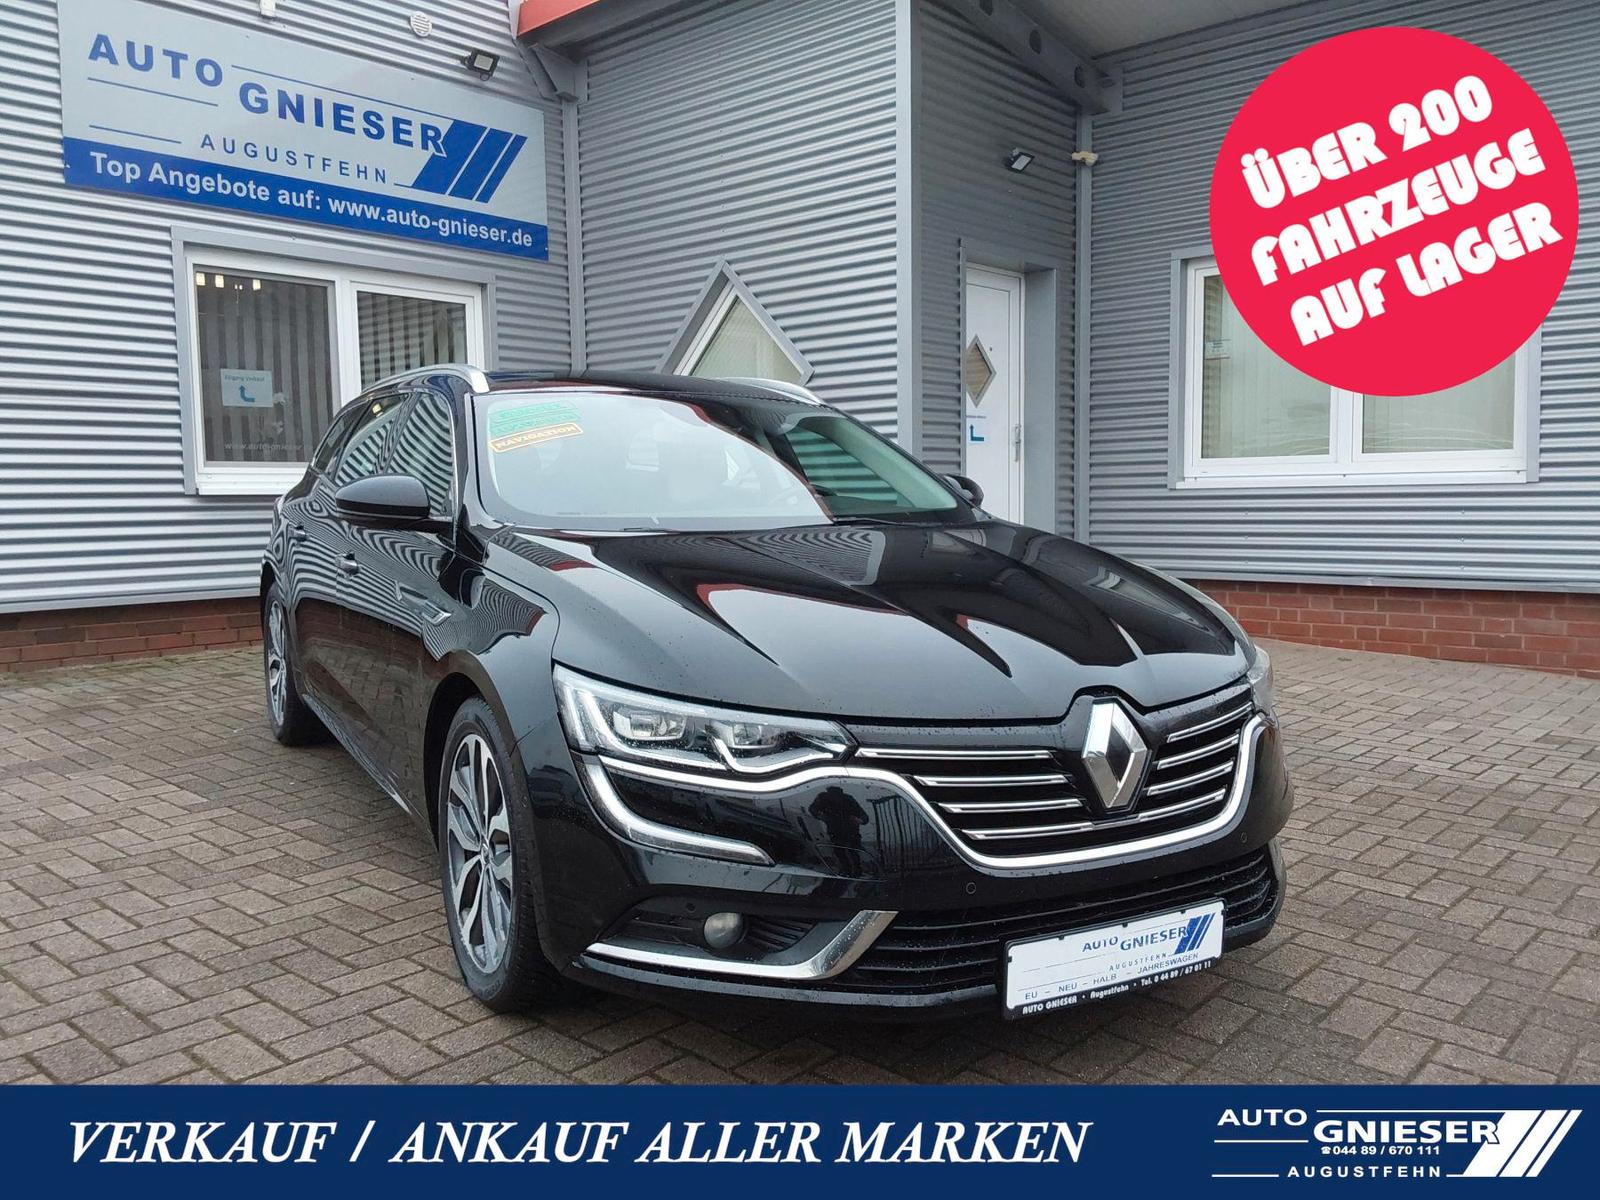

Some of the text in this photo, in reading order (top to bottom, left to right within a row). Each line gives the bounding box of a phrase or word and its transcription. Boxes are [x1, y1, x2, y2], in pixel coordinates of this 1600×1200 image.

[88, 33, 447, 158] AUTO GNIESER
[200, 133, 388, 184] AUGUSTFEHN
[90, 151, 533, 248] Top Angebote auf: www.auto-gnieser.de
[1082, 926, 1188, 953] AUTO GNIESER
[1109, 953, 1167, 972] AUGUSTFEHN
[1022, 1003, 1044, 1015] AUTO
[1046, 995, 1078, 1010] GNIESER
[1090, 984, 1130, 999] Augustfehn
[1141, 976, 1153, 987] Tel.
[1025, 991, 1038, 1000] EU
[1058, 982, 1078, 993] NEU
[1093, 973, 1117, 985] HALB
[1137, 952, 1199, 975] JAHRESWAGEN
